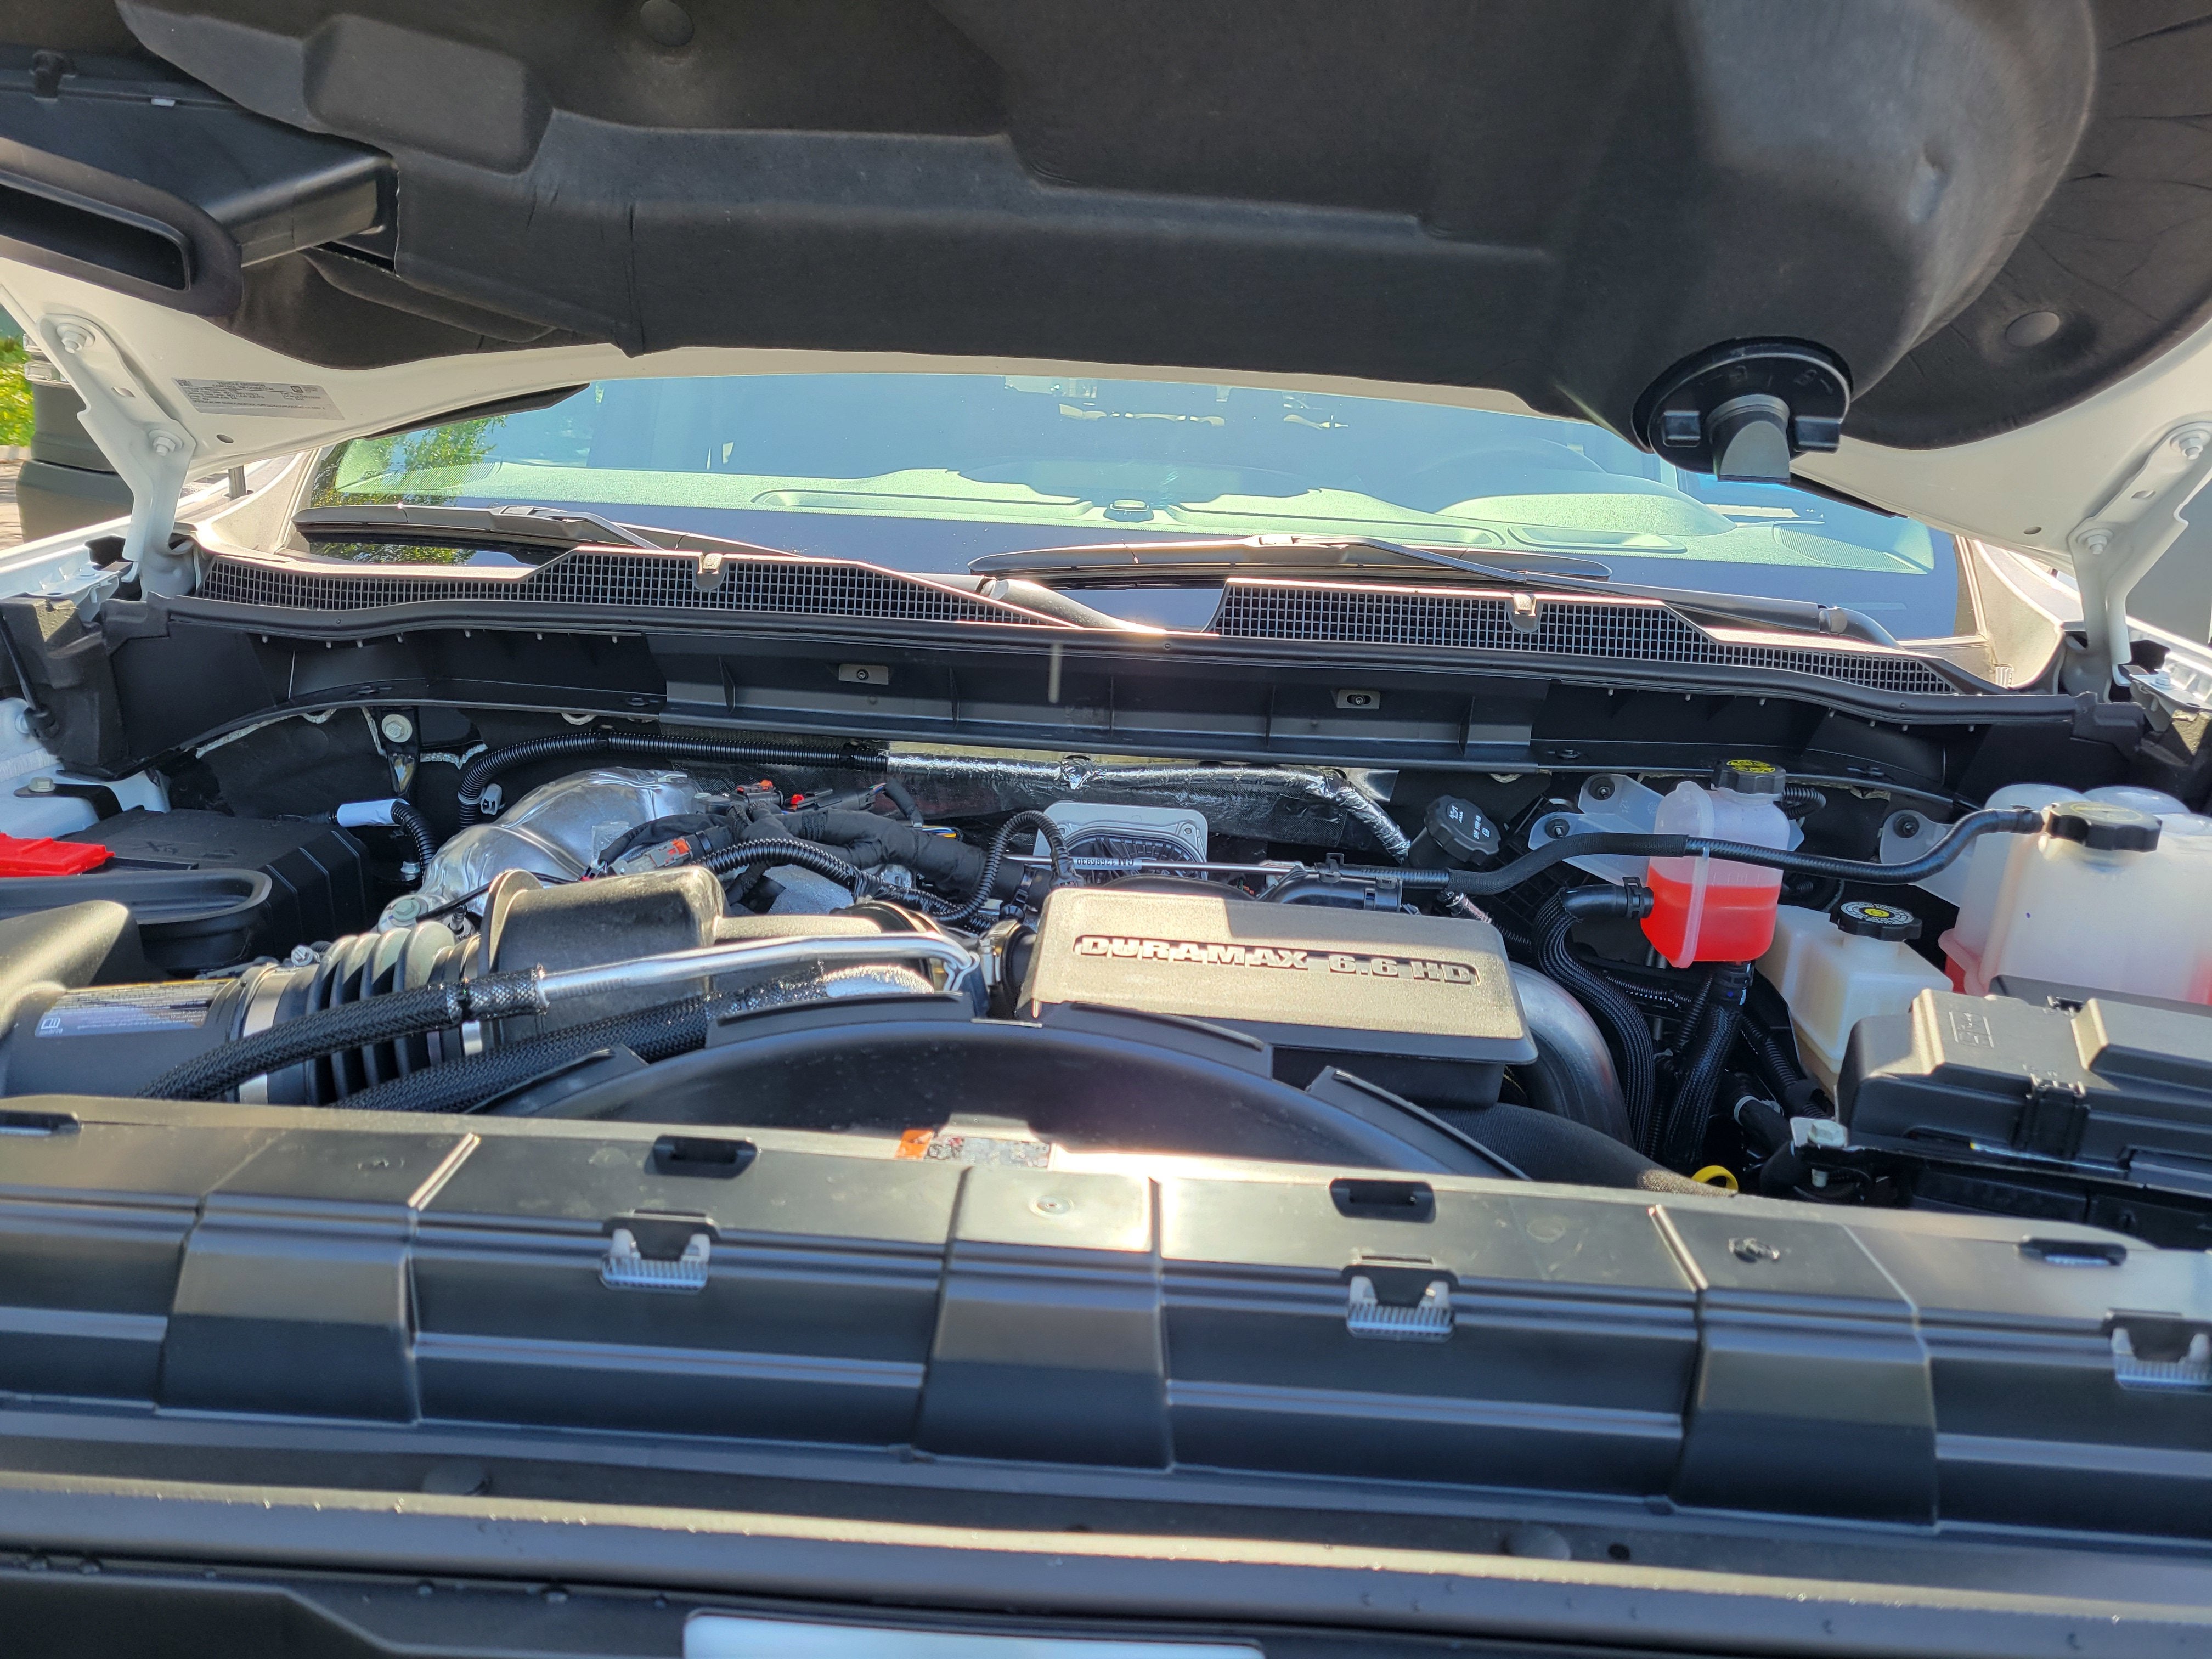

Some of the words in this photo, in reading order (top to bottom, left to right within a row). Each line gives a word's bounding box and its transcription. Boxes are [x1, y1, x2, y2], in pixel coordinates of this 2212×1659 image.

[1081, 936, 1308, 970] DURAMAX
[1329, 955, 1399, 977] 6.6
[1410, 961, 1472, 985] HD
